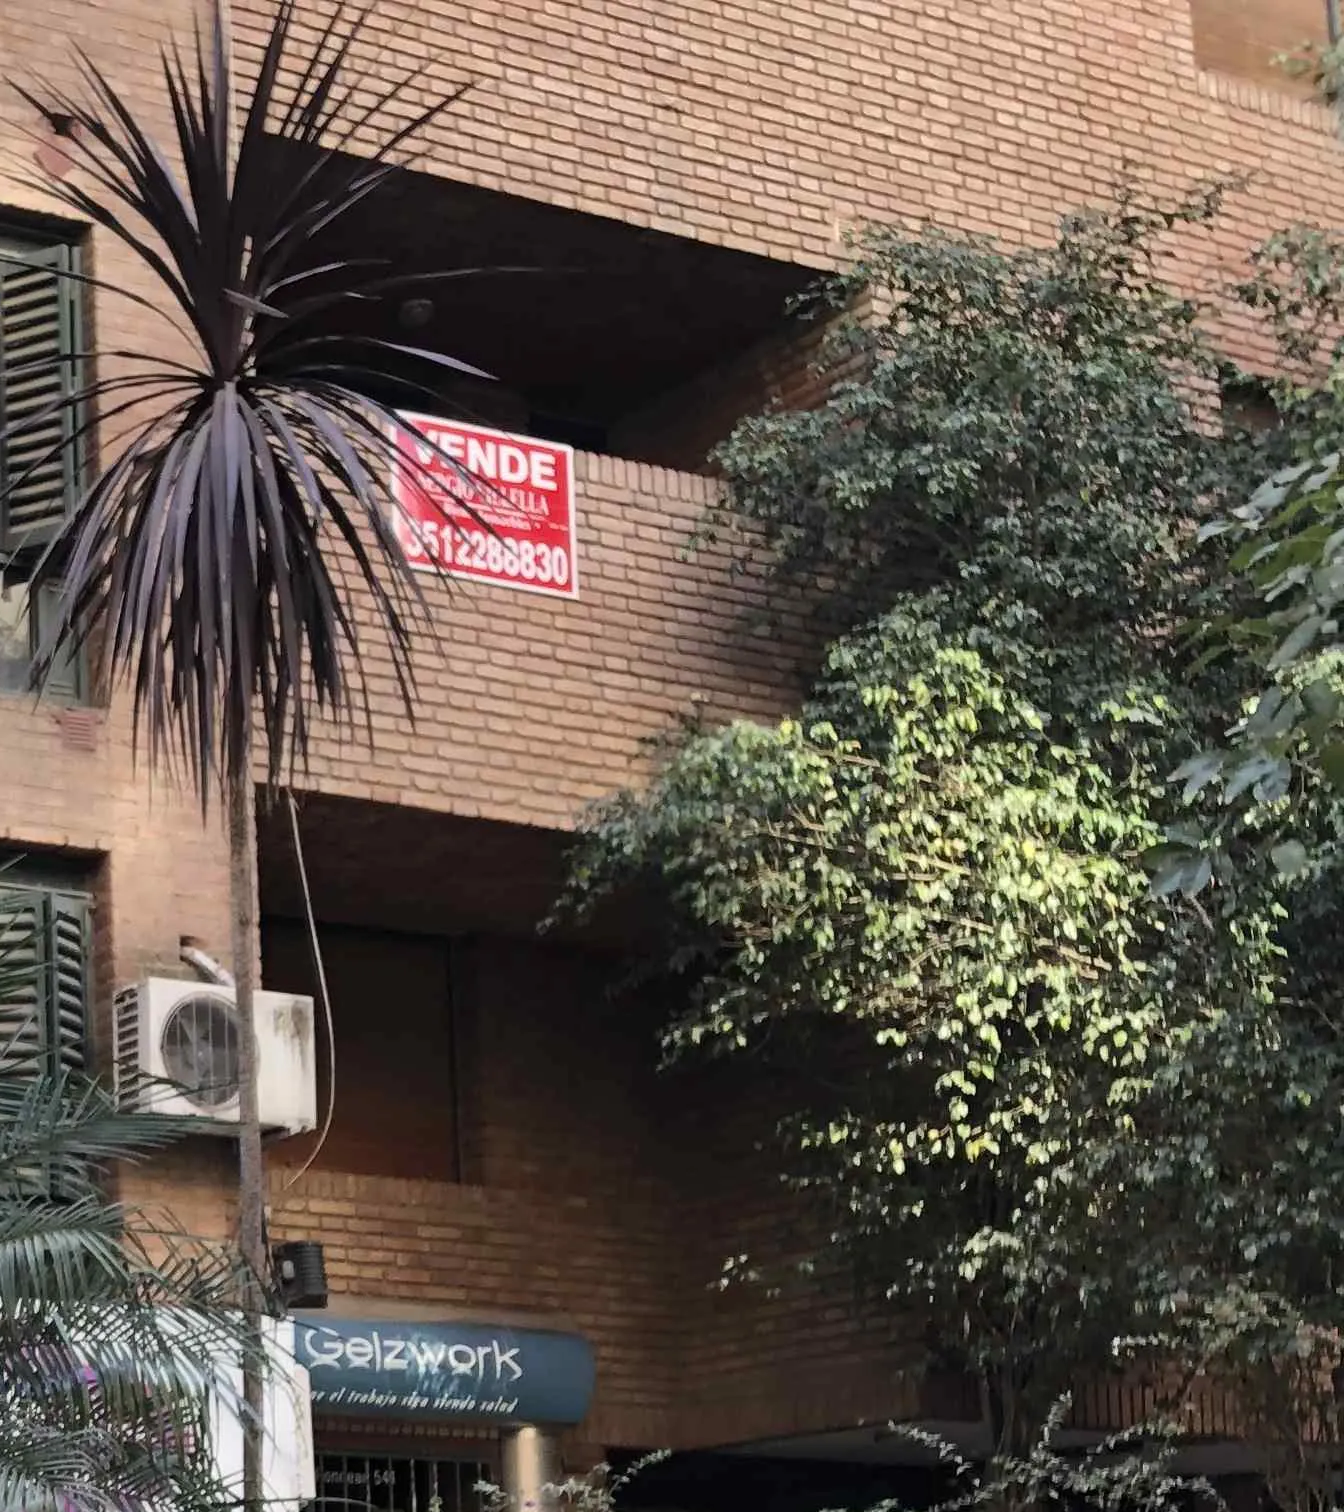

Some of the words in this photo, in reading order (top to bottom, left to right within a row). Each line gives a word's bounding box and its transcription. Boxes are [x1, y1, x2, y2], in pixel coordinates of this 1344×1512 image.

[412, 430, 557, 491] VENDE
[304, 1327, 523, 1382] Gelzwork
[347, 1388, 397, 1408] trabajo
